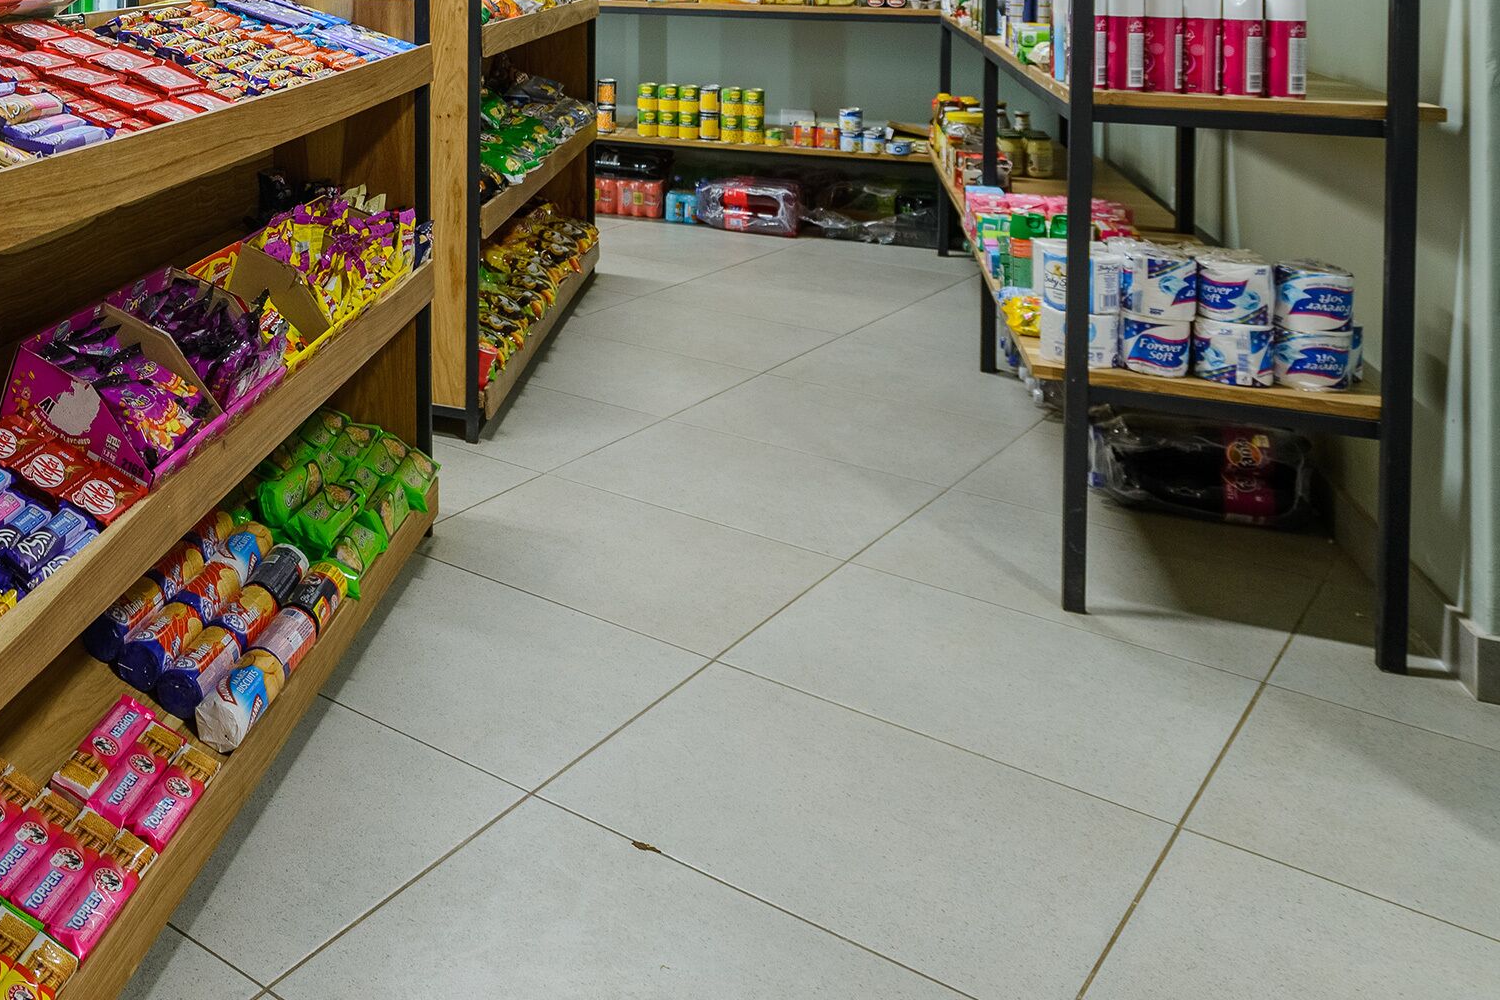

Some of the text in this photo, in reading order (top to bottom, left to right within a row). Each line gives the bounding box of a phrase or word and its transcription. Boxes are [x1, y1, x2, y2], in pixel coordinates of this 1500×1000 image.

[1203, 285, 1233, 296] rever
[1140, 340, 1182, 354] Forever
[32, 455, 65, 487] KitKat
[82, 481, 115, 514] KitKat
[236, 669, 259, 695] BISCUITS
[111, 711, 139, 738] TOPPER
[107, 772, 138, 805] TOPPER
[144, 797, 176, 830] TOPPER
[23, 869, 64, 910] TOPPER
[67, 888, 103, 931] TOPPER
